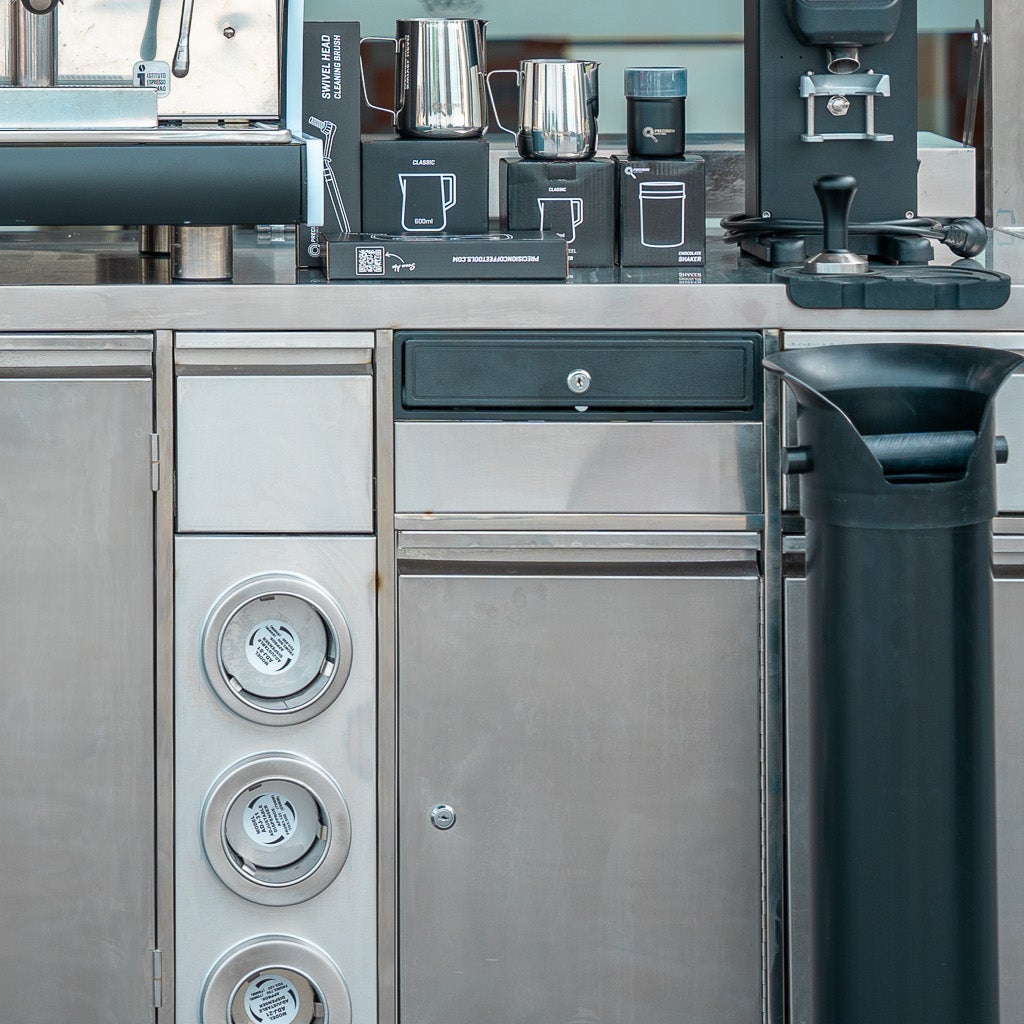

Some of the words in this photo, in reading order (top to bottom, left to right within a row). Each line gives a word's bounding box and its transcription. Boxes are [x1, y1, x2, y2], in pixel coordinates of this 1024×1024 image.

[321, 35, 331, 61] HEAD
[333, 35, 342, 62] BRUSH
[321, 65, 331, 100] SWIVEL
[333, 63, 342, 100] CLEANING
